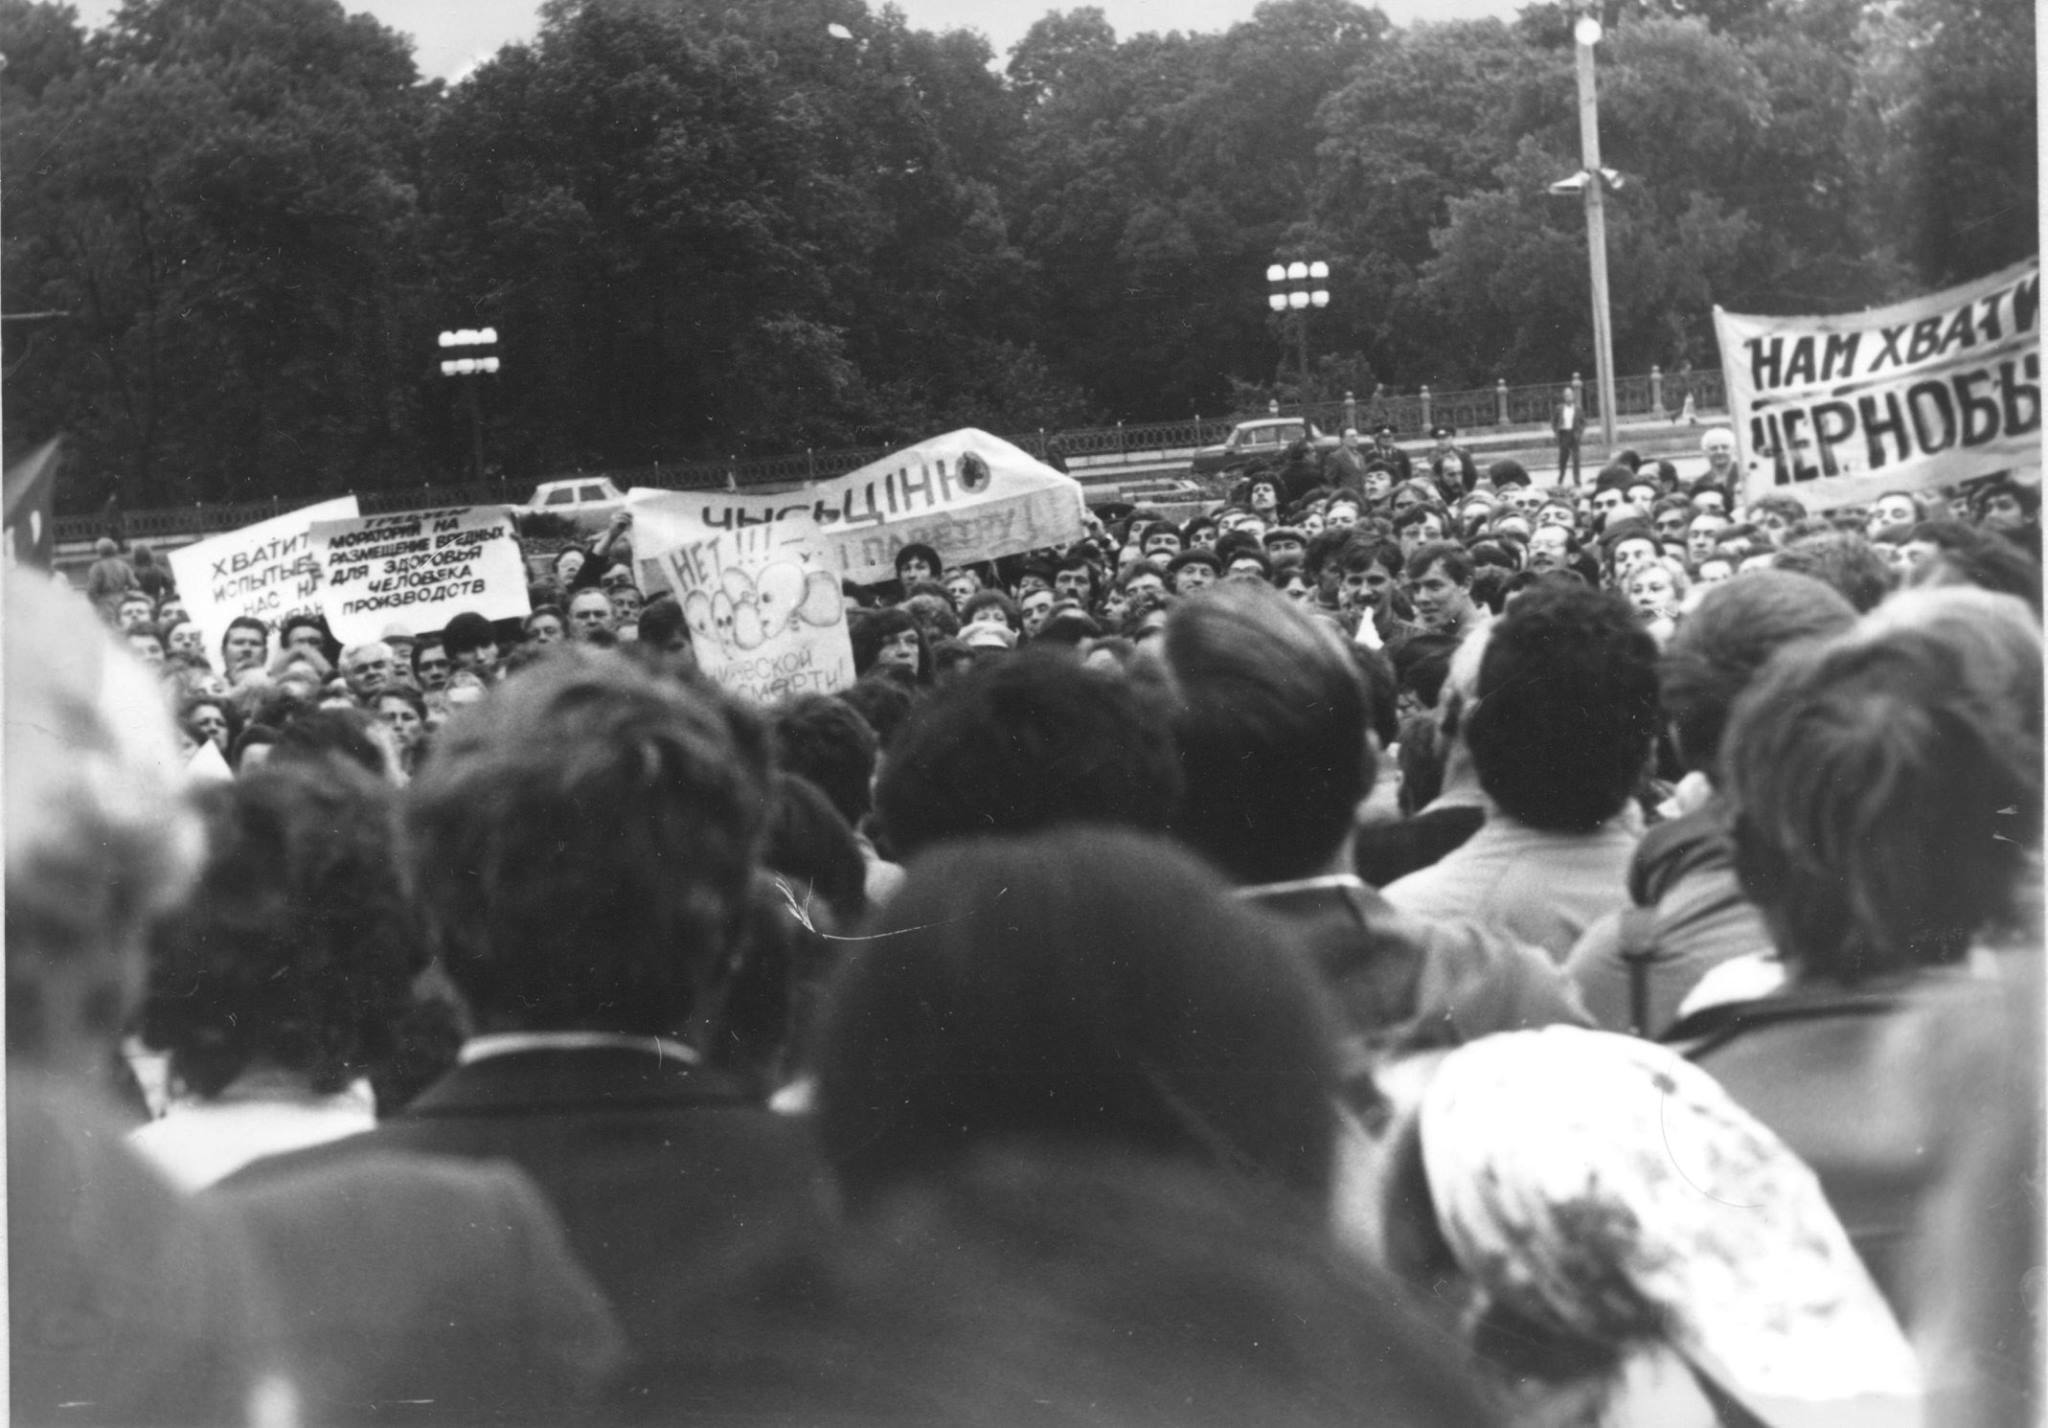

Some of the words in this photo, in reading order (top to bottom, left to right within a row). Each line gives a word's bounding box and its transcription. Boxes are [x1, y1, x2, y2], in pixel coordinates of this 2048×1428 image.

[1744, 332, 1862, 391] НАМ
[328, 518, 422, 549] МОРАТОРИЙ
[433, 512, 460, 532] НА
[328, 537, 431, 567] РАЗМЕЩЕНИЕ
[435, 525, 504, 549] ВРЕДНЫХ
[212, 531, 310, 580] ХВАТИТ
[329, 564, 369, 586] ДЛЯ
[383, 545, 483, 574] ЗДОРОВЬЯ
[342, 578, 485, 615] ПРОИЗВОДСТВ
[368, 564, 473, 593] ЧЕЛОВЕКА
[243, 591, 281, 617] НАС
